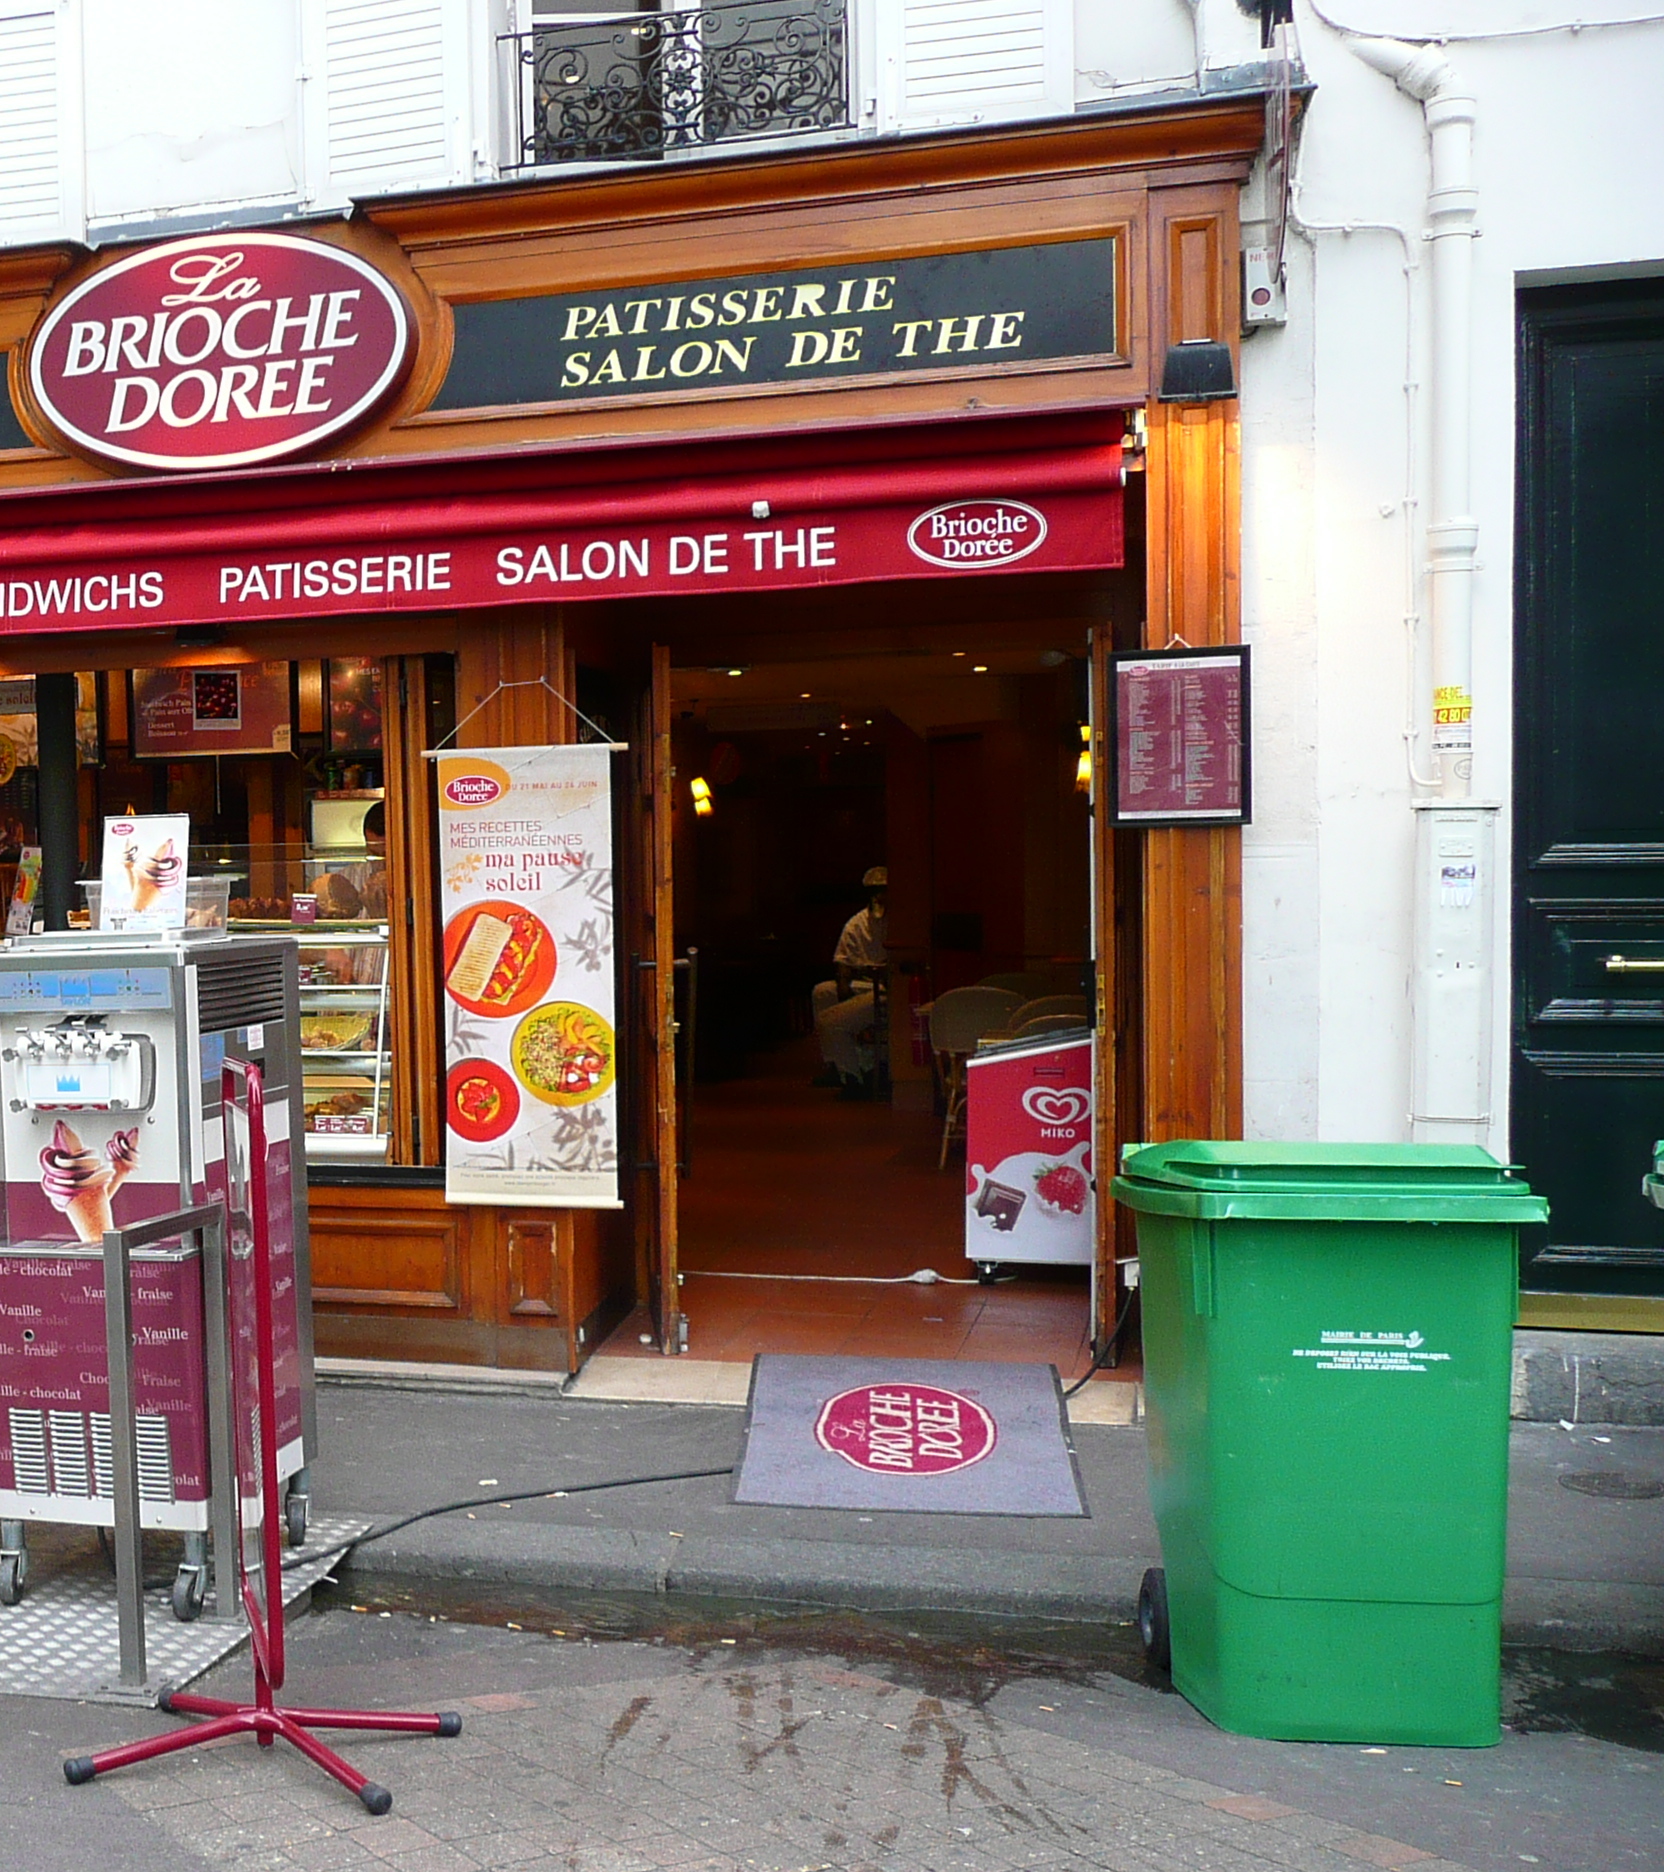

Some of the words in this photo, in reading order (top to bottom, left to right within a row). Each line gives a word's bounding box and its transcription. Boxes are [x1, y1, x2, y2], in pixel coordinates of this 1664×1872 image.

[161, 251, 262, 307] La
[561, 276, 896, 341] PATISSERIE
[62, 289, 361, 378] BRIOCHE
[561, 337, 757, 388] SALON
[786, 326, 863, 368] DE
[893, 311, 1026, 358] THE
[104, 355, 335, 434] DOREE
[930, 509, 1028, 539] Brioche
[942, 533, 1014, 559] Dorée
[220, 552, 451, 604] PATISSERIE
[496, 538, 650, 586] SALON
[669, 534, 728, 575] DE
[744, 526, 836, 572] THE
[148, 721, 174, 729] Dessert
[453, 781, 494, 794] Brioche
[577, 780, 598, 788] JUIN
[450, 822, 476, 833] MES
[479, 820, 542, 833] RECETTES
[450, 833, 583, 849] MÉDITERRANÉENNES
[485, 853, 515, 869] ma
[522, 850, 584, 871] pause
[486, 872, 542, 893] soleil
[20, 1264, 73, 1277] chocolat
[130, 1266, 161, 1279] raise
[137, 1287, 173, 1300] fraise
[142, 1326, 189, 1340] Vanille
[1377, 1332, 1403, 1340] PARIS
[24, 1344, 58, 1357] fraise
[80, 1371, 109, 1384] Choc
[143, 1374, 182, 1387] Fraise
[30, 1386, 81, 1400] chocolat
[135, 1403, 160, 1415] aise
[868, 1390, 914, 1468] BRIOCHE
[175, 1473, 200, 1486] olat
